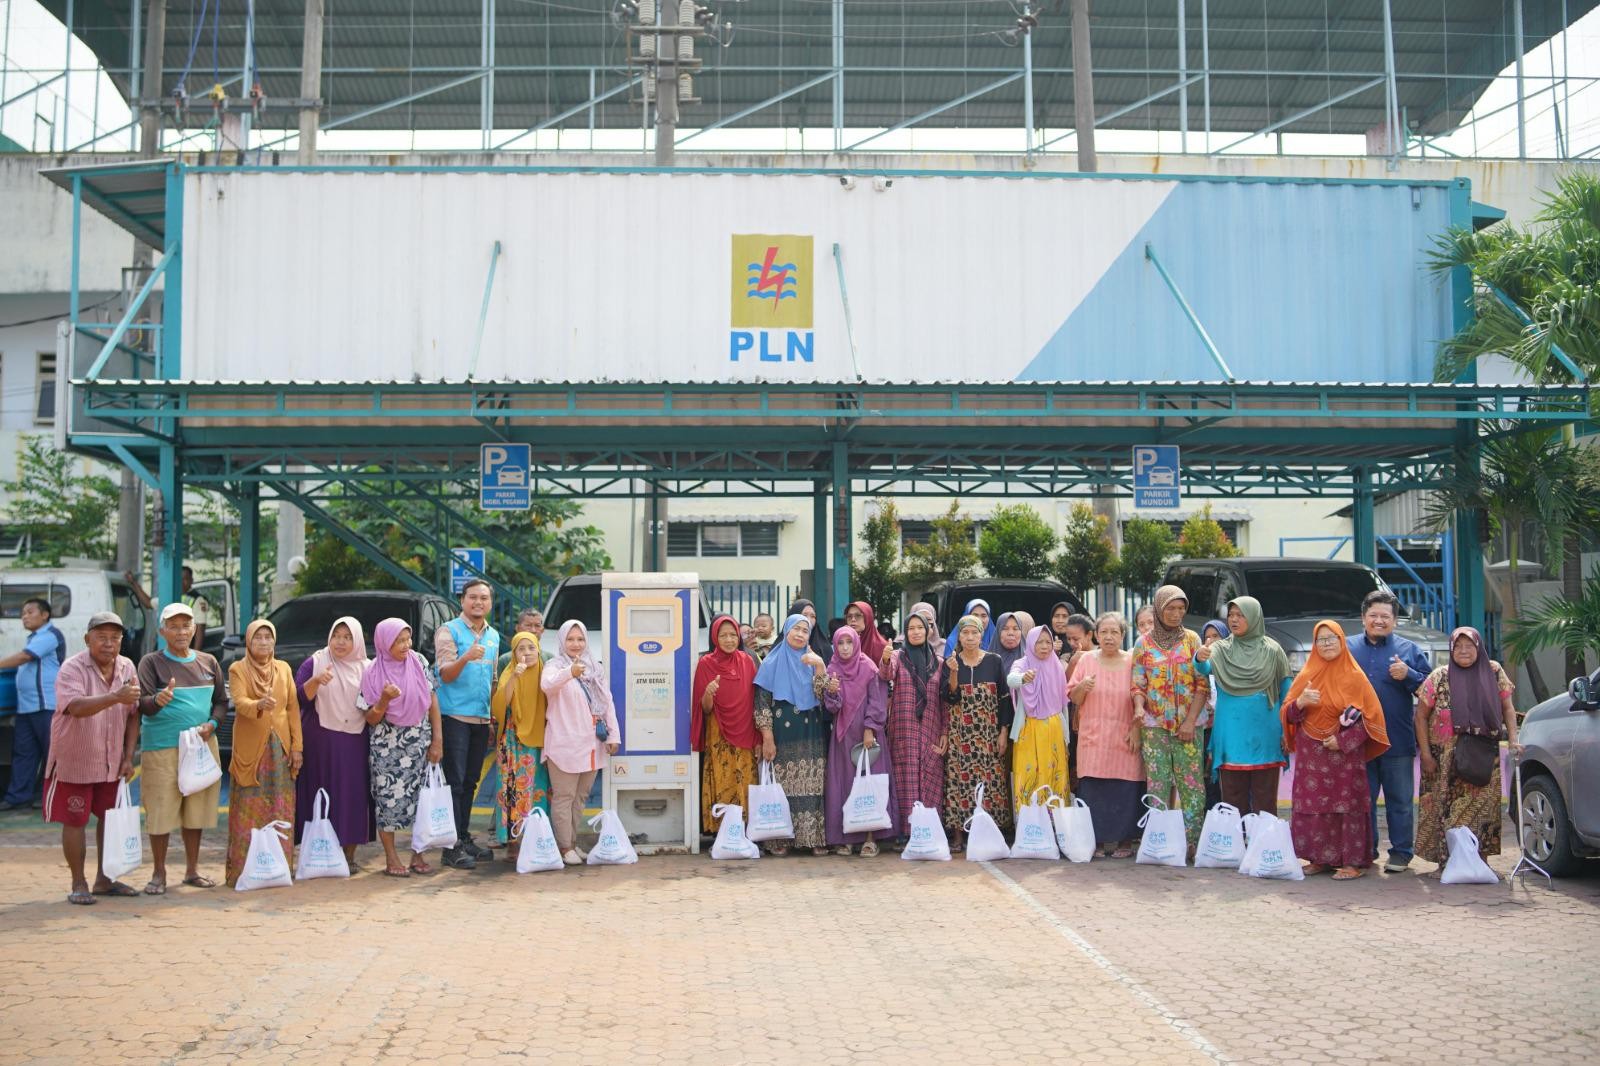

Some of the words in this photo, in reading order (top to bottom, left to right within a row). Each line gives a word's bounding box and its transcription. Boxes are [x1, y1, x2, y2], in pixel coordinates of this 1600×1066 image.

[730, 331, 814, 362] PLN
[484, 447, 508, 475] P
[1136, 448, 1158, 475] P
[1143, 490, 1171, 498] PARKIR
